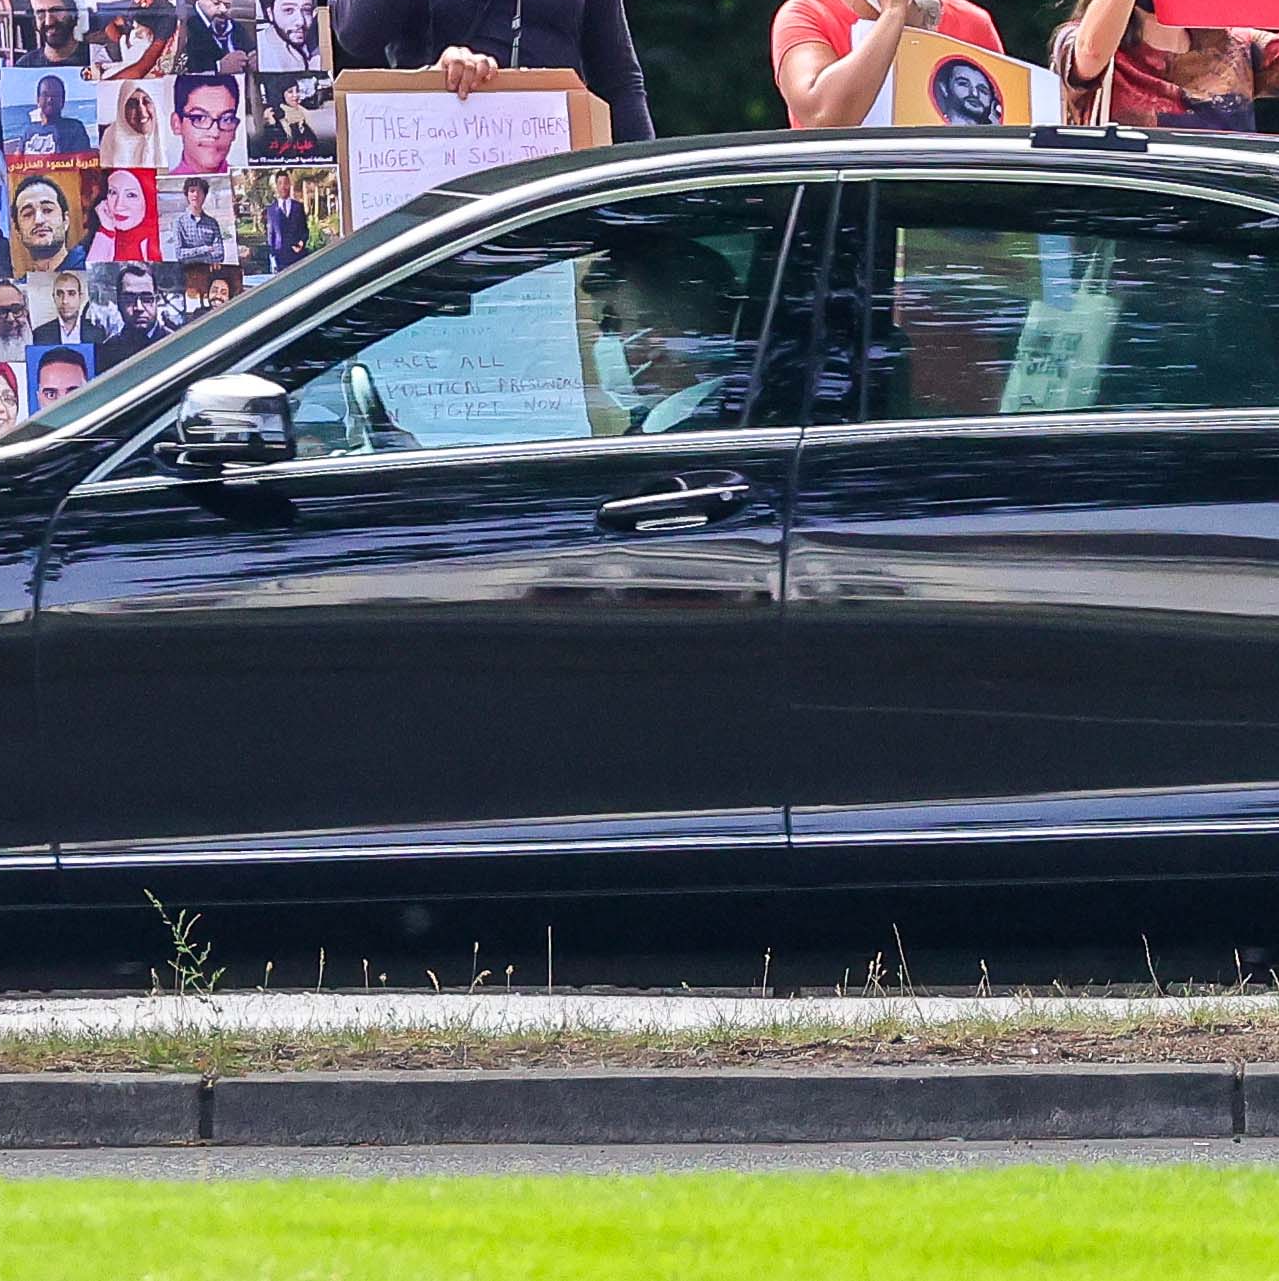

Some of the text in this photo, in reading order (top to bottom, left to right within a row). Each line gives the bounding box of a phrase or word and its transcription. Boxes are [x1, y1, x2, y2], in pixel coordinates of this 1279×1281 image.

[365, 116, 422, 142] THEY
[427, 123, 458, 140] and
[463, 114, 513, 140] MANY
[358, 149, 424, 170] LINGER
[443, 149, 456, 166] IN
[460, 354, 505, 370] ALL
[385, 381, 486, 400] POLITICAL
